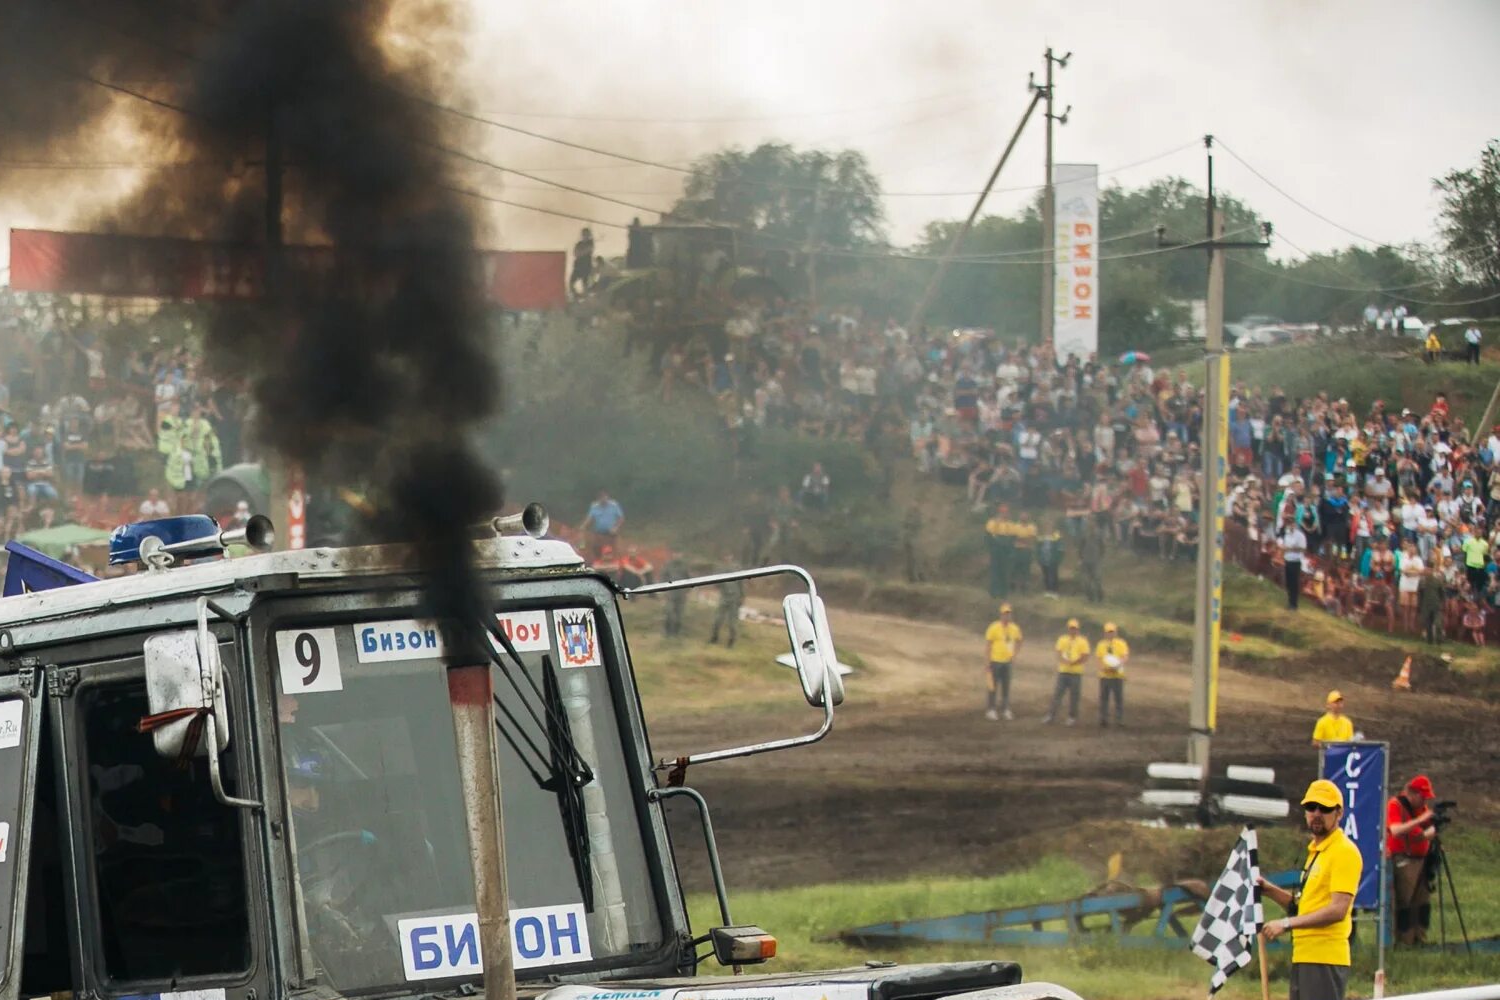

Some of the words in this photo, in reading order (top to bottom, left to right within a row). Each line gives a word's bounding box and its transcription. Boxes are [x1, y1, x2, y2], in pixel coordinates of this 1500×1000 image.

[294, 632, 321, 686] 9
[1344, 751, 1361, 841] СТА
[409, 912, 581, 971] БИОН
